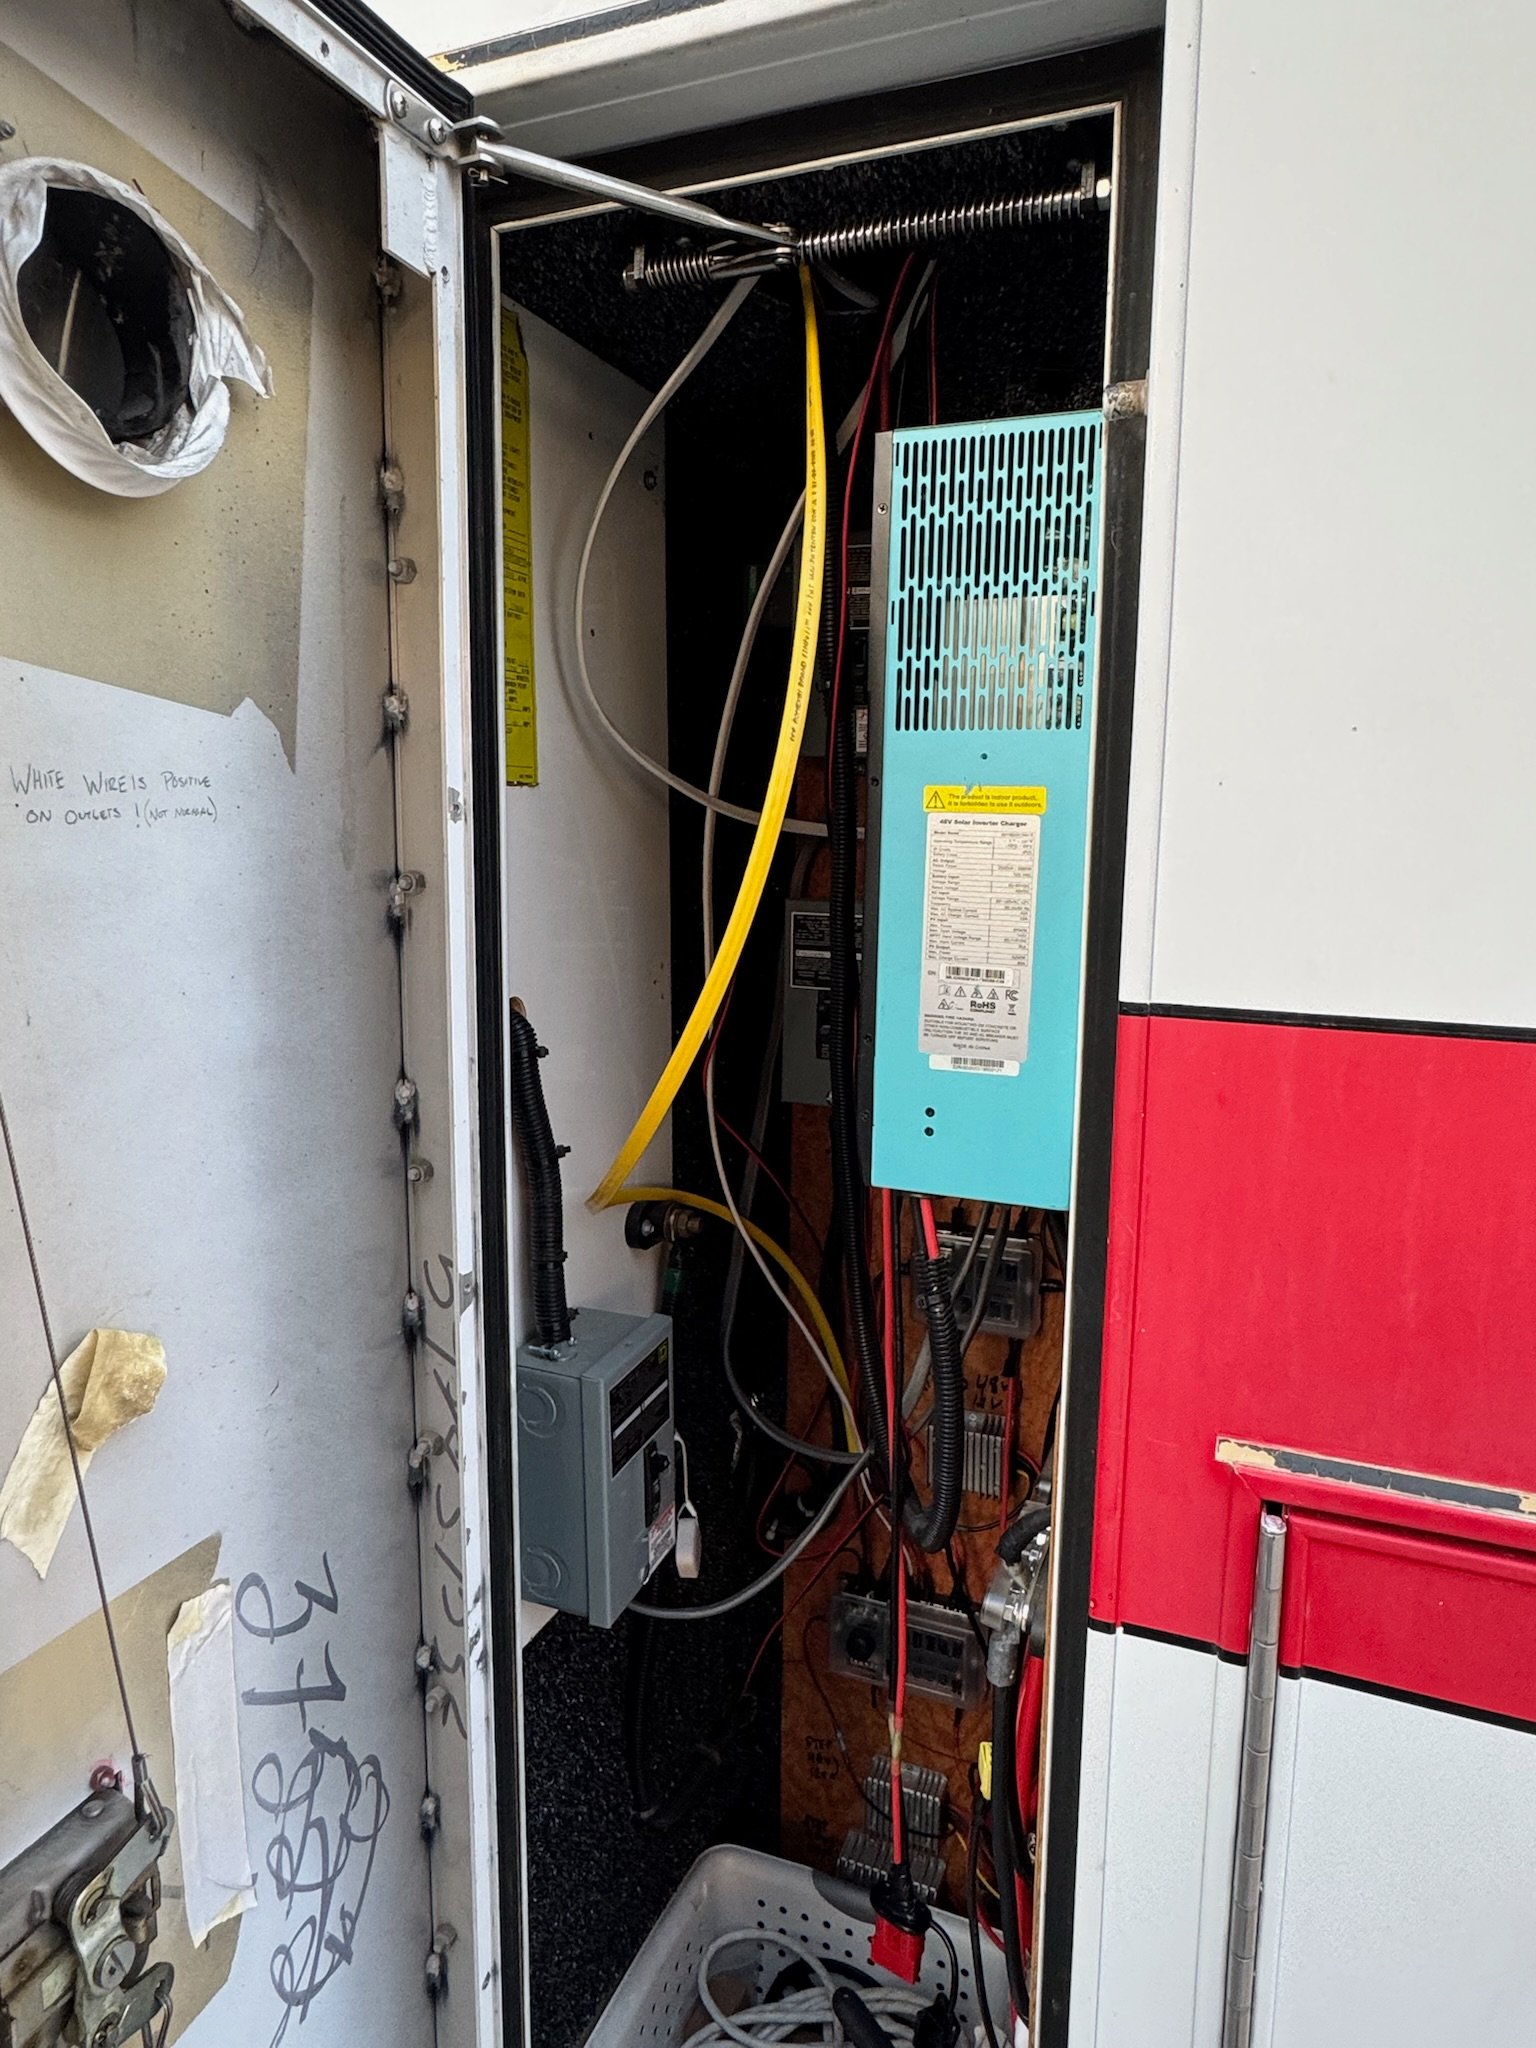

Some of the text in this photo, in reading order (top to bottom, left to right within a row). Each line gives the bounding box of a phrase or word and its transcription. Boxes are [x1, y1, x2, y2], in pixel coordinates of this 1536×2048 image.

[83, 771, 127, 795] WIRE
[26, 809, 51, 823] ON
[64, 807, 122, 825] OUTLETS
[1000, 820, 1028, 828] Charger
[970, 1000, 996, 1009] RoHS
